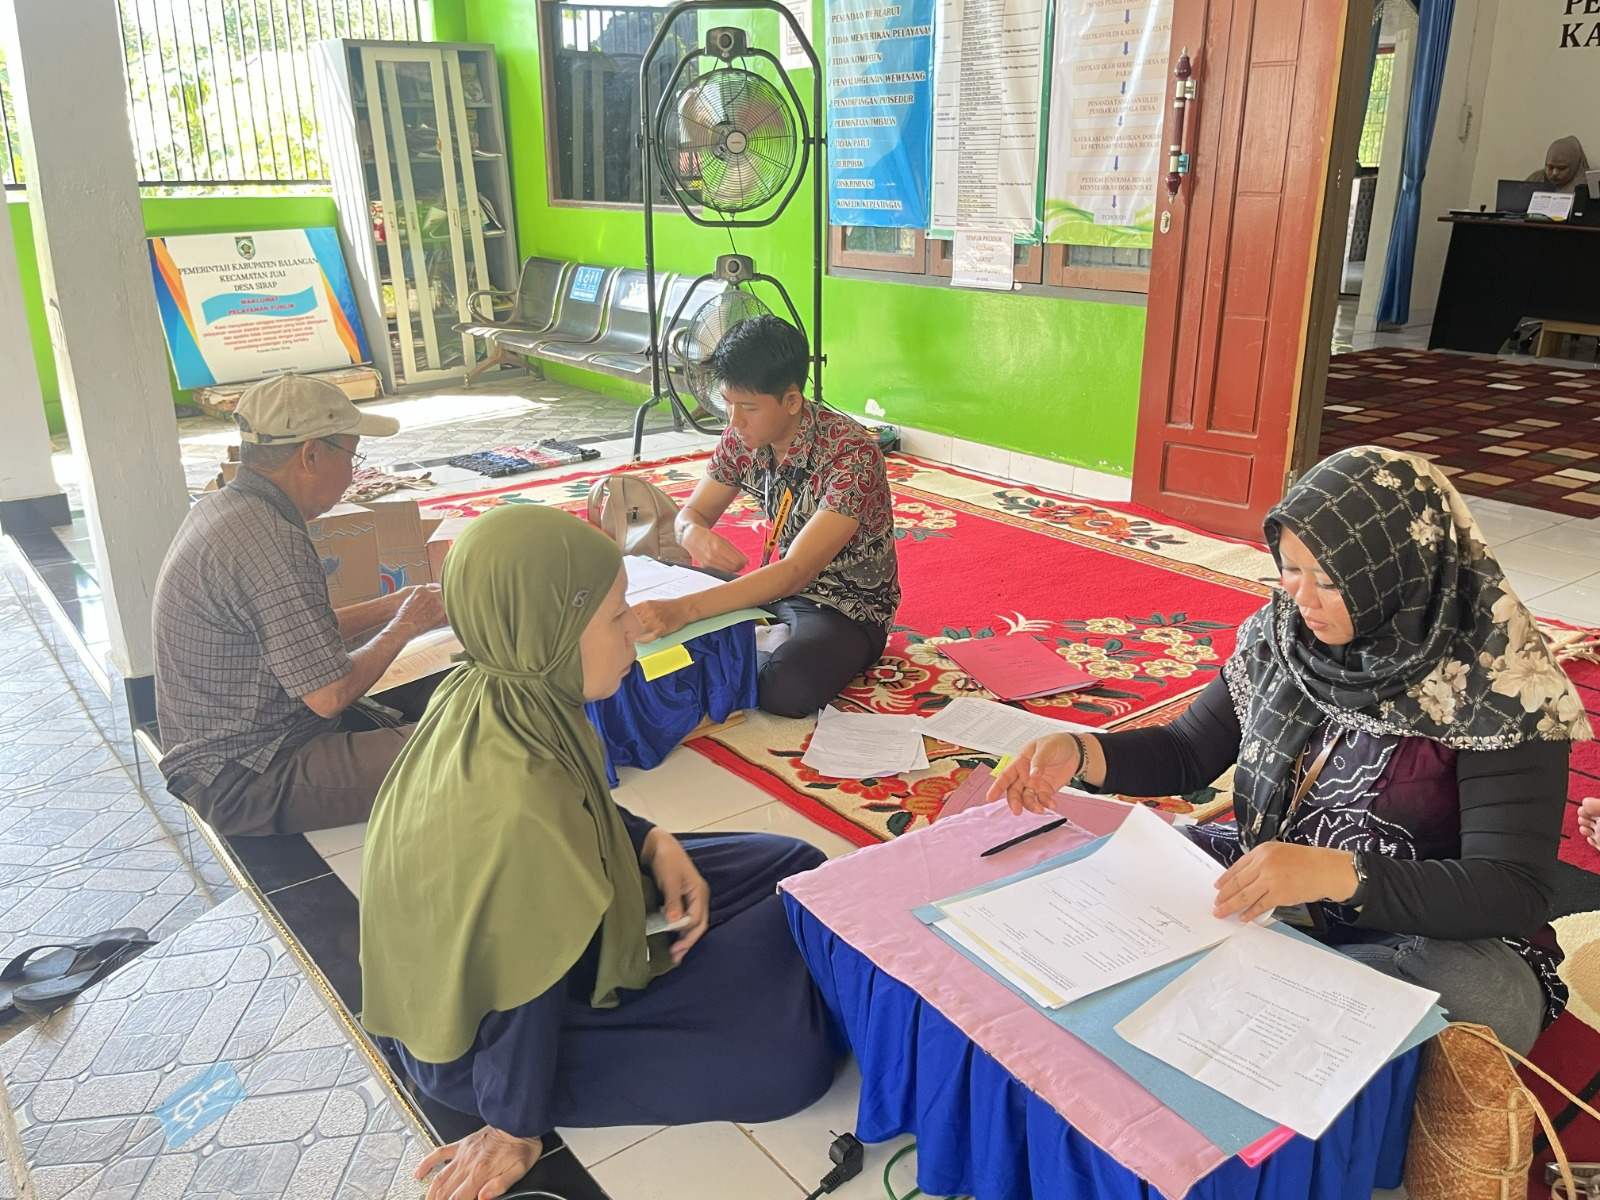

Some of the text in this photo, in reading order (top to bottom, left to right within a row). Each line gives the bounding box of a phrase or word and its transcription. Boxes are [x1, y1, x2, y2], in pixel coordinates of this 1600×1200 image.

[866, 6, 900, 19] BERLARUT
[832, 36, 849, 44] TIDAK
[850, 30, 891, 42] MEMBERIKAN
[1559, 22, 1600, 48] KA
[832, 56, 849, 66] TIDAK
[885, 72, 925, 82] WEWENANG
[834, 94, 914, 107] PENYIMPANGAN PROSEDUR
[835, 117, 896, 128] PERMINTAAN IMBALAN
[836, 139, 870, 148] TIDAK PATUT
[836, 160, 864, 168] BERPIHAK
[862, 200, 902, 209] KEPENTINGAN
[178, 257, 319, 276] PEMERINTAH KABUPATEN BALANGAN
[220, 272, 268, 282] KECAMATAN
[256, 282, 278, 290] SIRAP
[241, 296, 278, 304] MAKLUMAT
